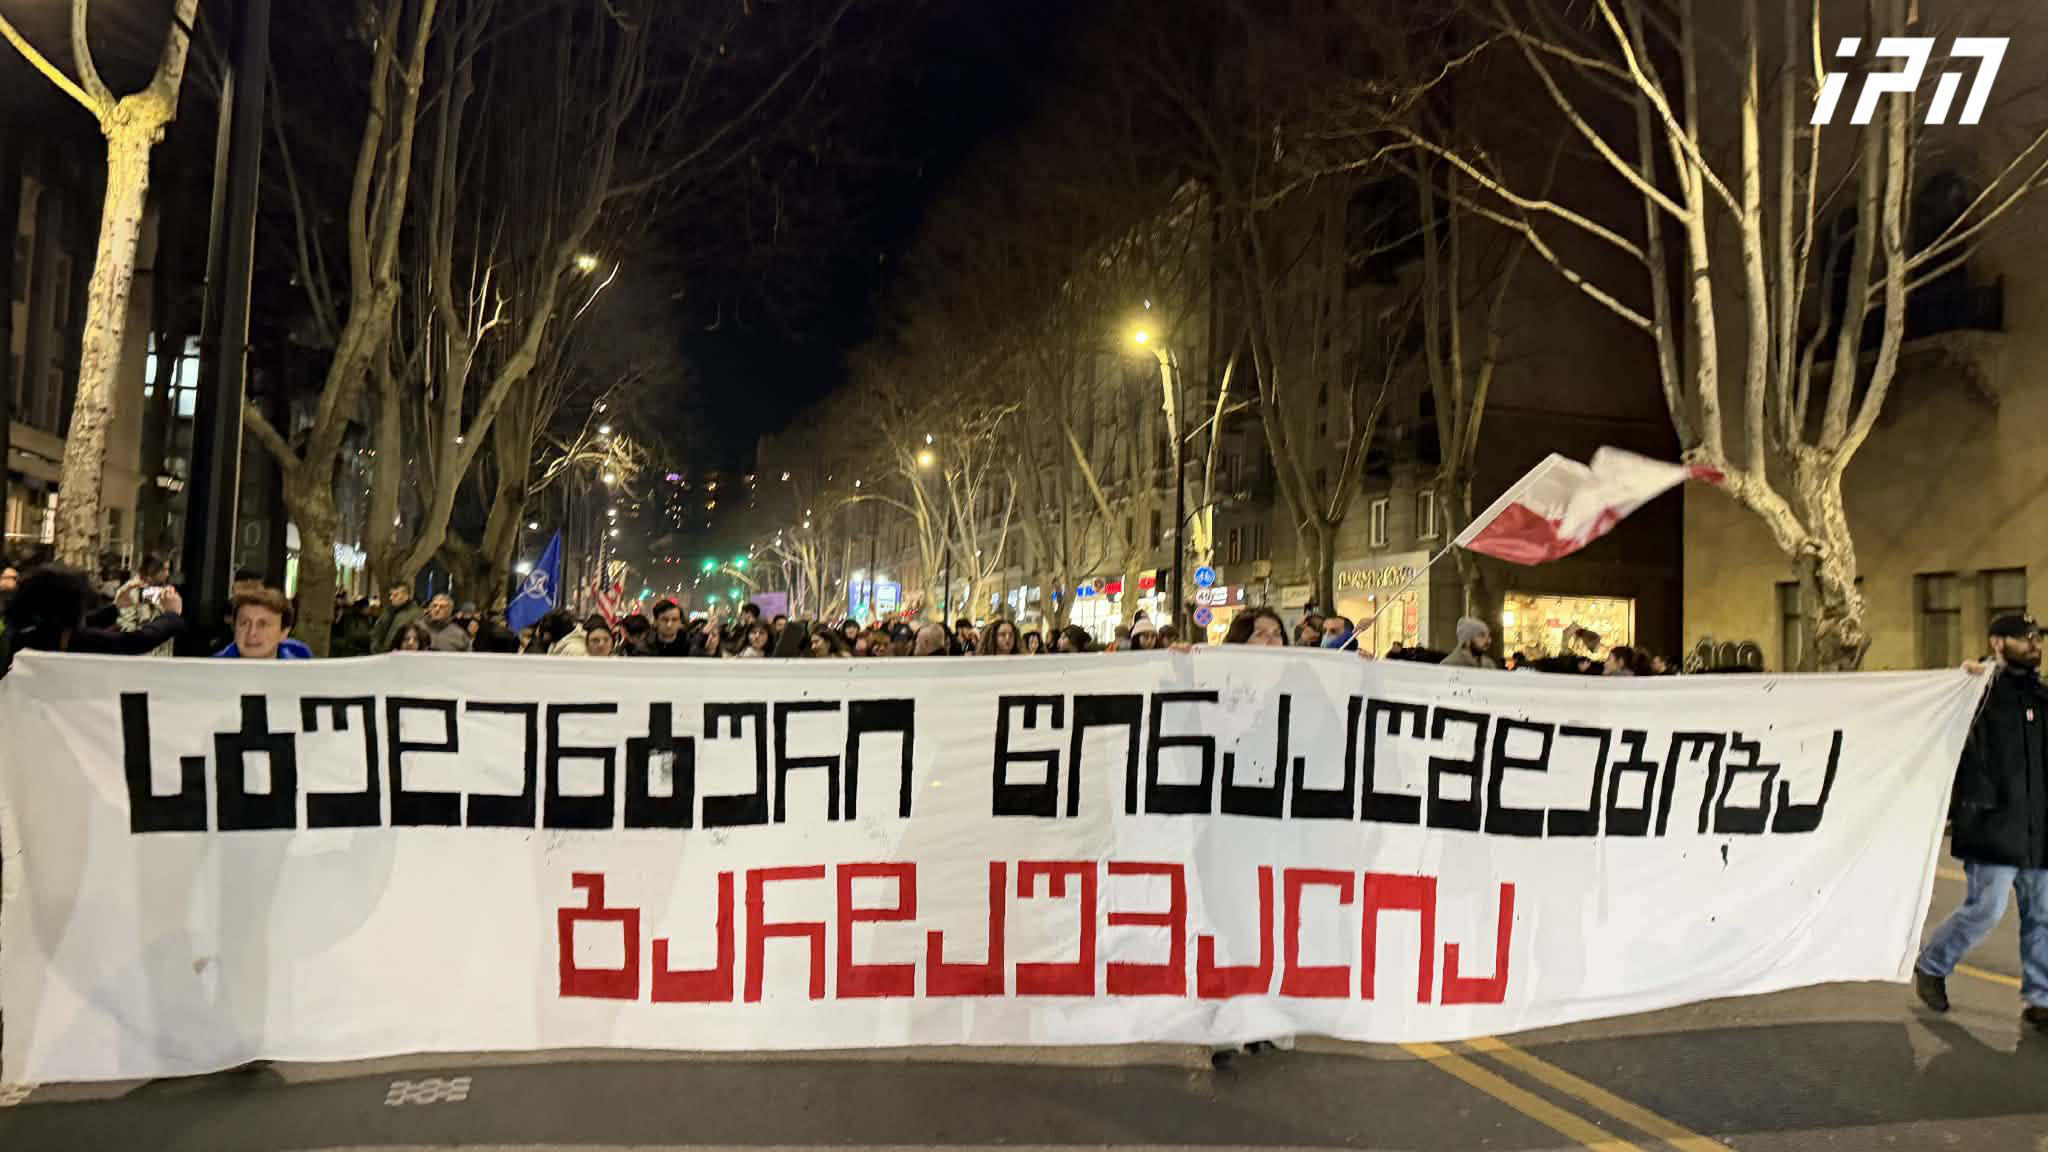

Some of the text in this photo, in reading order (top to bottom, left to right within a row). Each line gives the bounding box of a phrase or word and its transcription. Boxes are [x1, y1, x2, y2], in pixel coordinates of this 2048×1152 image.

[120, 691, 1842, 837] სტუდენტური წინააღმდეგობა
[558, 860, 1515, 1005] გარდაუვალია
